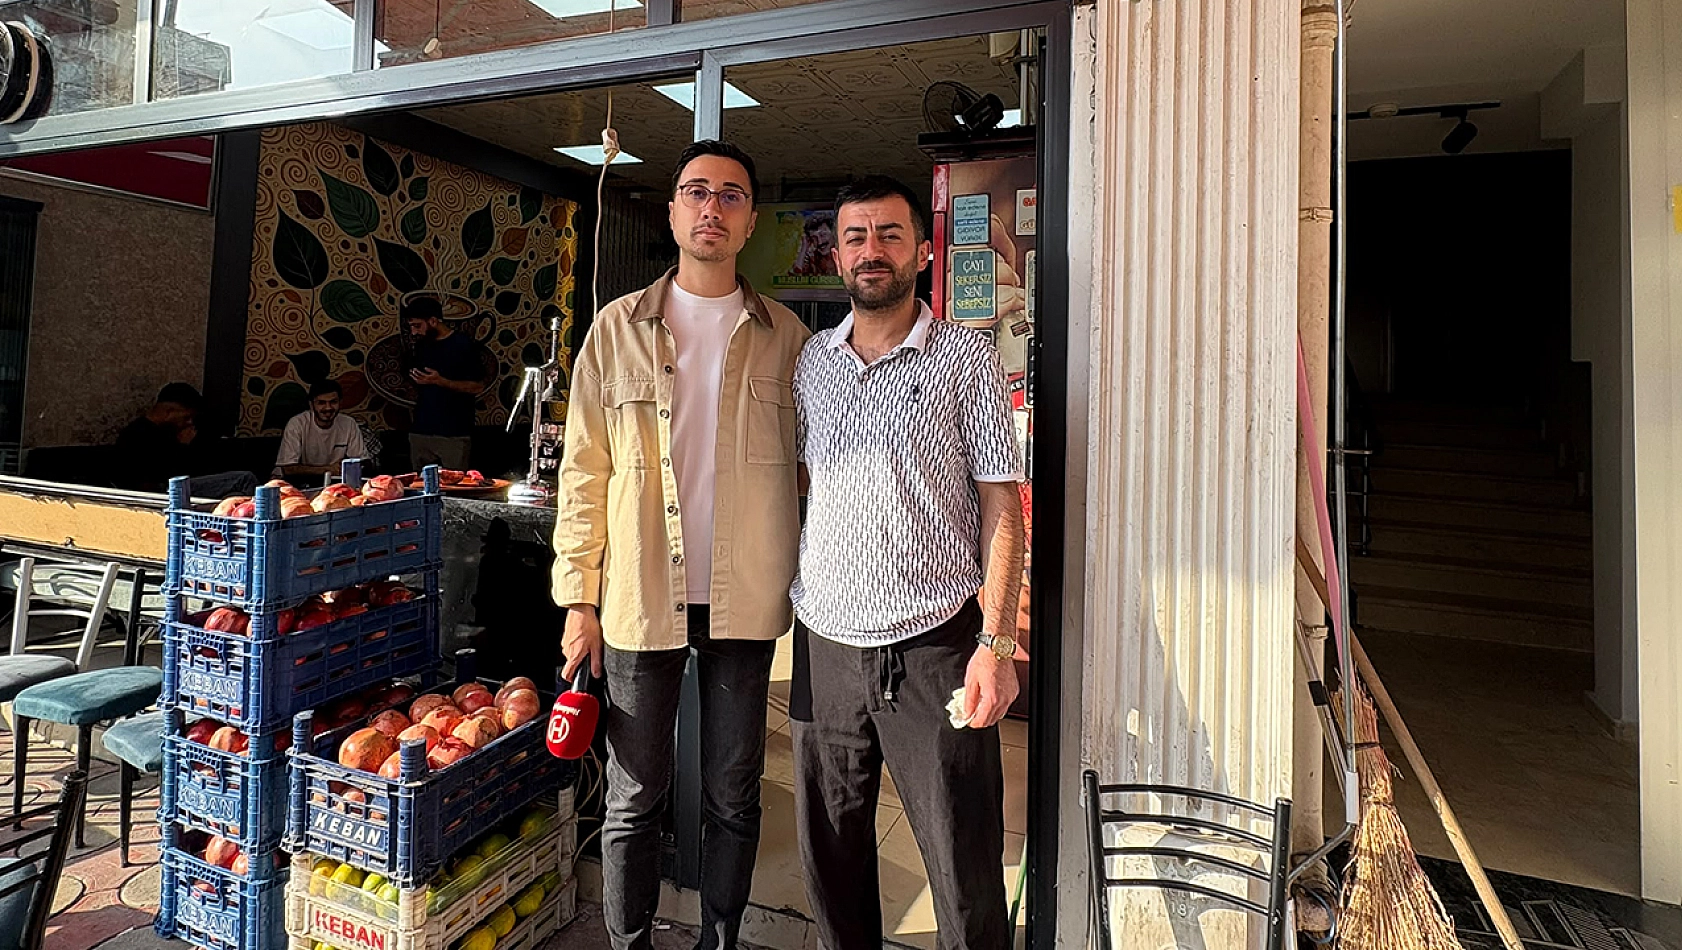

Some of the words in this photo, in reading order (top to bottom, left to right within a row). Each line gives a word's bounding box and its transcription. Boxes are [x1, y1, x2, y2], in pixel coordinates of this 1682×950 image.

[962, 259, 984, 273] ÇAYI
[184, 555, 240, 581] KEBAN
[181, 669, 237, 699] KEBAN
[180, 785, 235, 819] KEBAN
[315, 812, 381, 846] KEBAN
[179, 899, 233, 935] KEBAN
[315, 909, 384, 950] KEBAN
